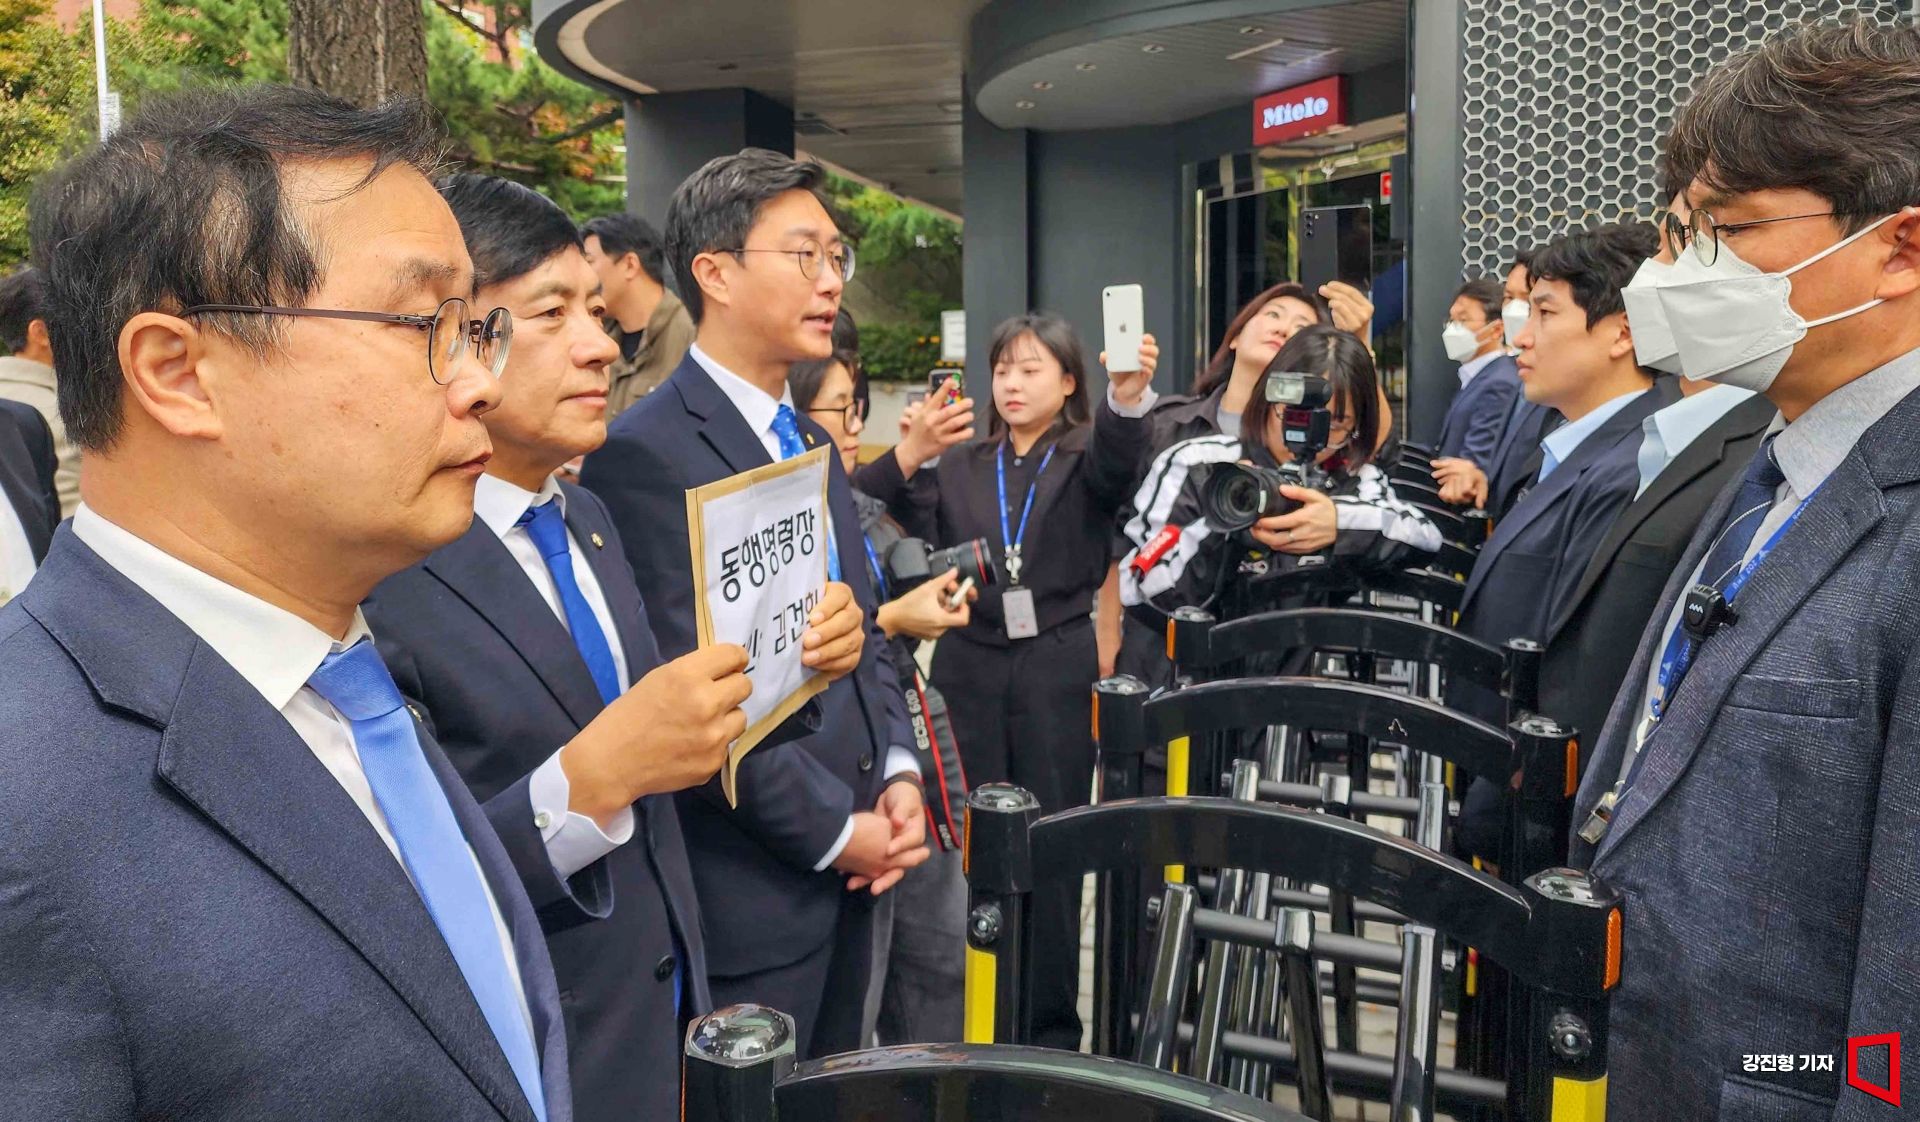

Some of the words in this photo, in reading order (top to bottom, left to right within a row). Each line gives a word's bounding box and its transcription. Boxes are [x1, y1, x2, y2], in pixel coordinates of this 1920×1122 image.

[1263, 97, 1329, 129] Miele
[720, 507, 815, 603] 동행명령장
[911, 714, 930, 751] EOS
